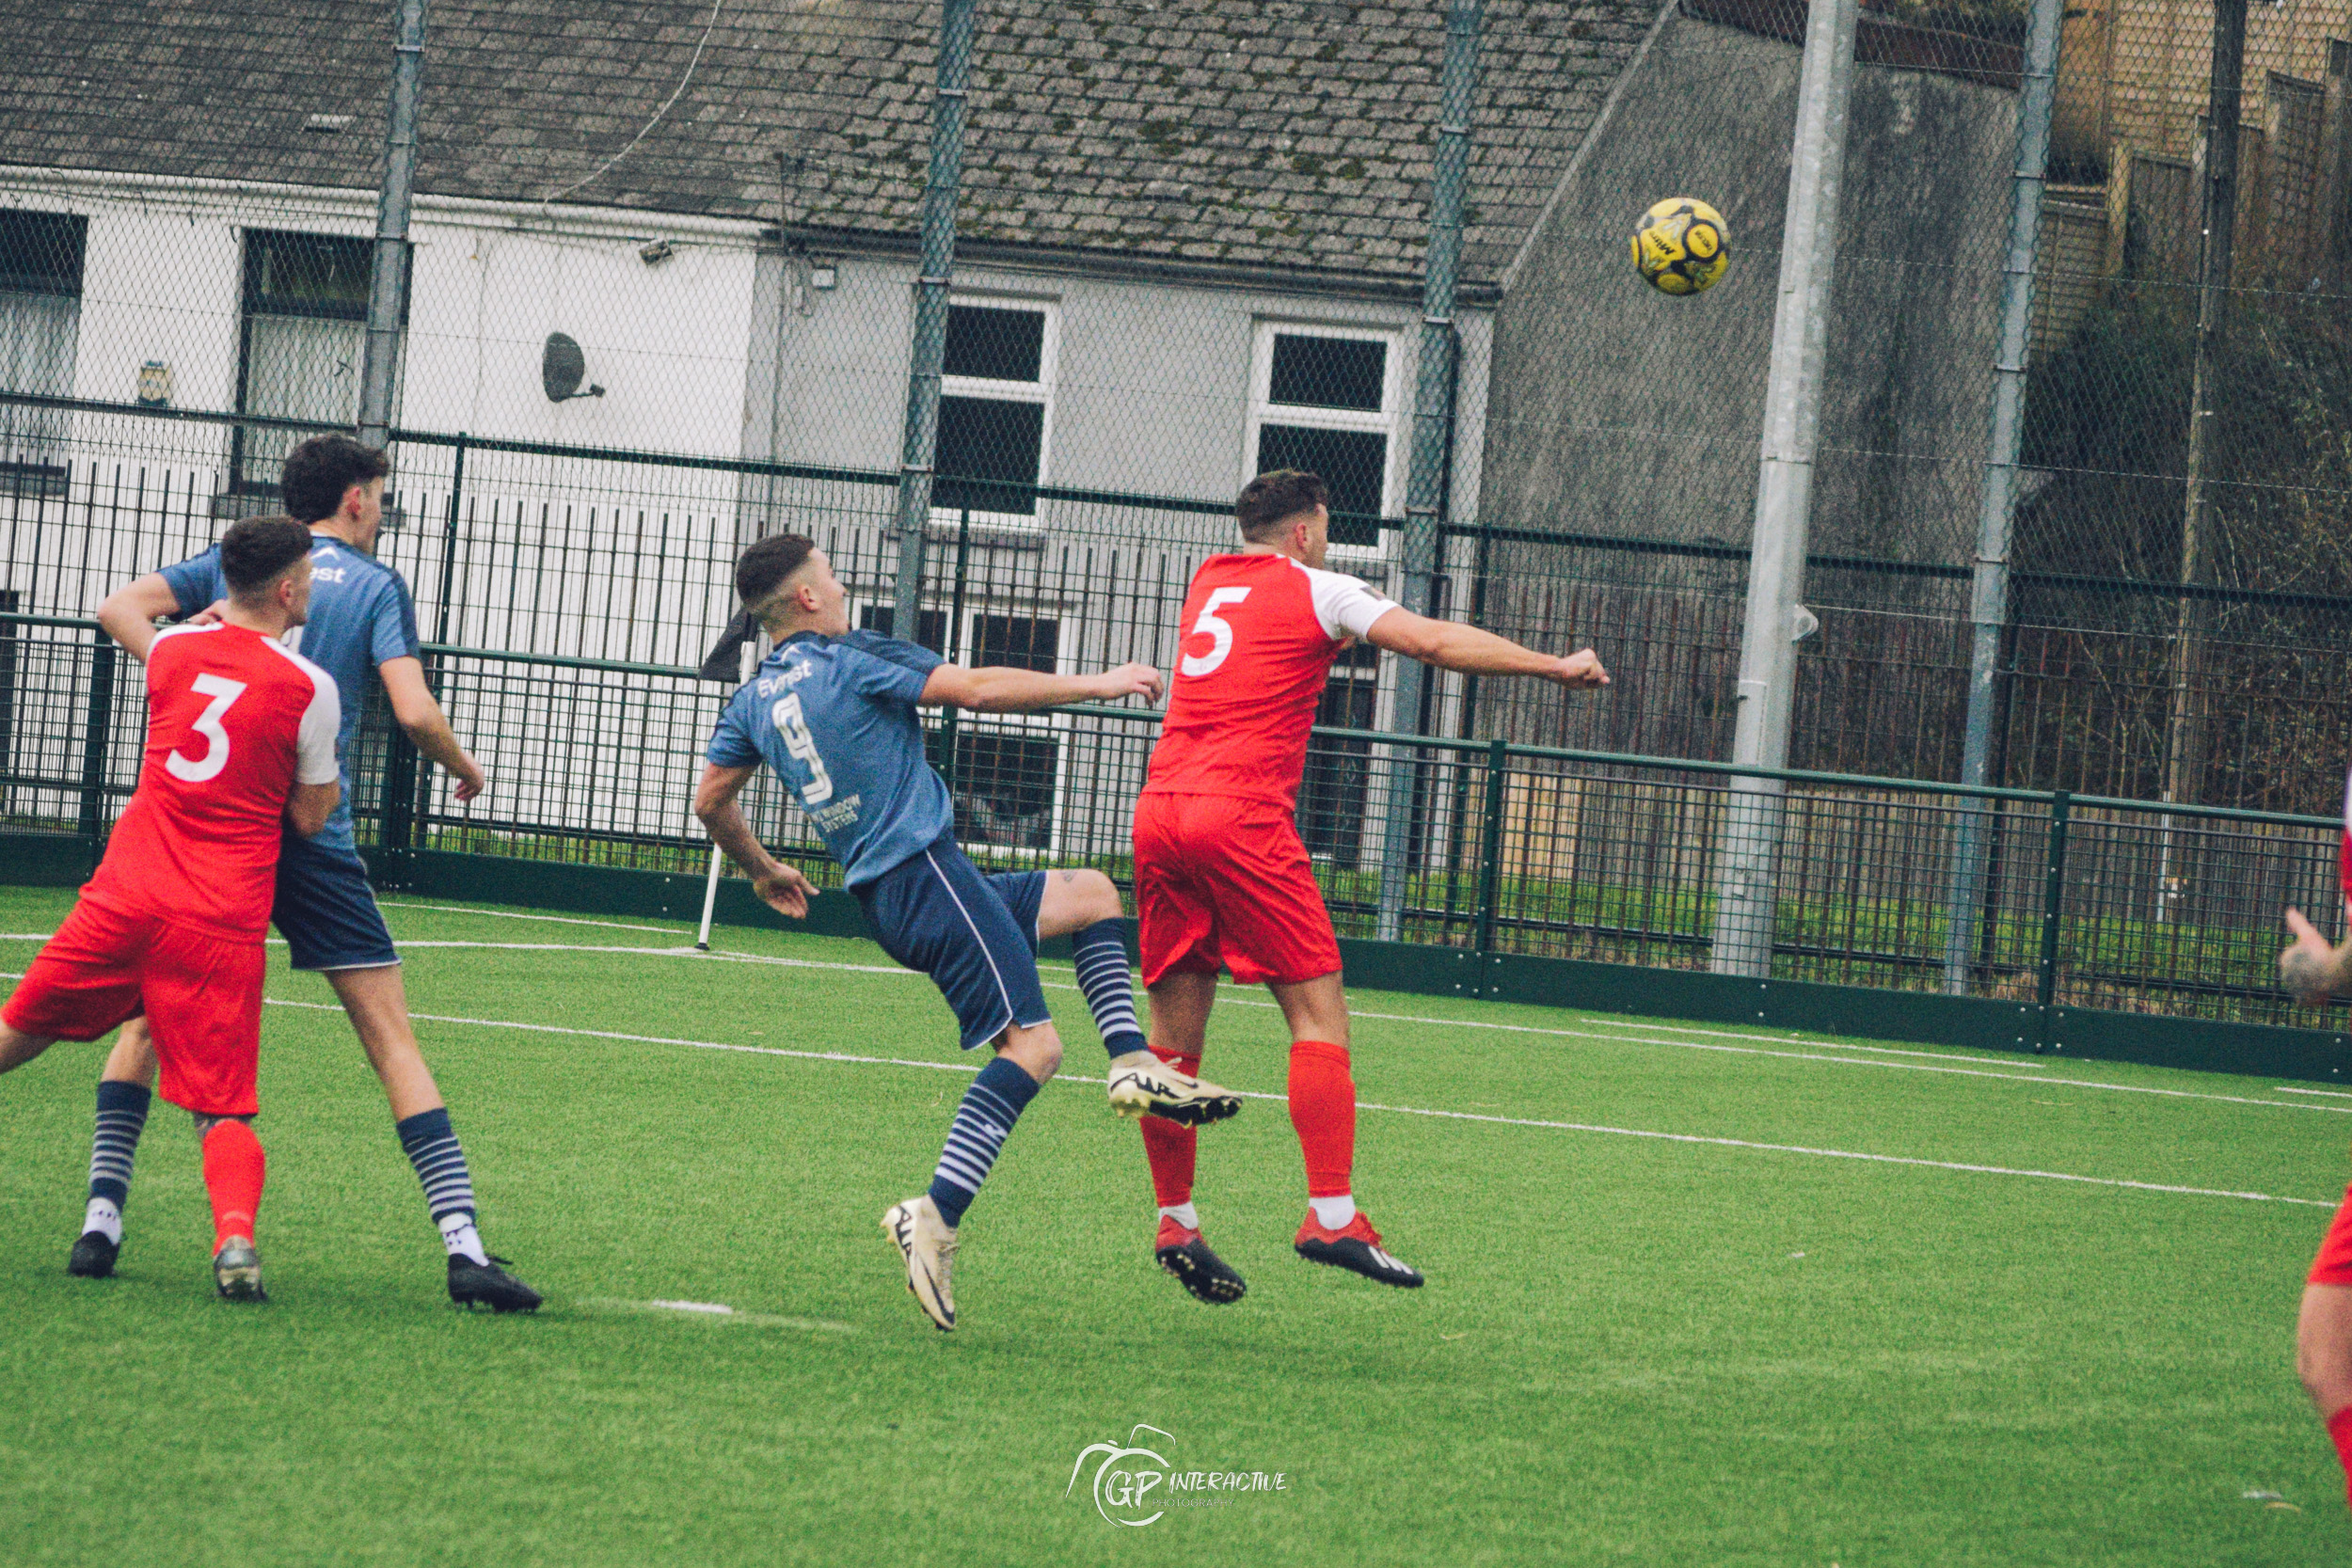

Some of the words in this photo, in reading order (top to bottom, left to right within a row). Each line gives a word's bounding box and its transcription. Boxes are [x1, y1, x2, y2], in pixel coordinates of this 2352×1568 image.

[1181, 586, 1252, 677] 5
[165, 672, 246, 783] 3
[771, 692, 834, 805] 9
